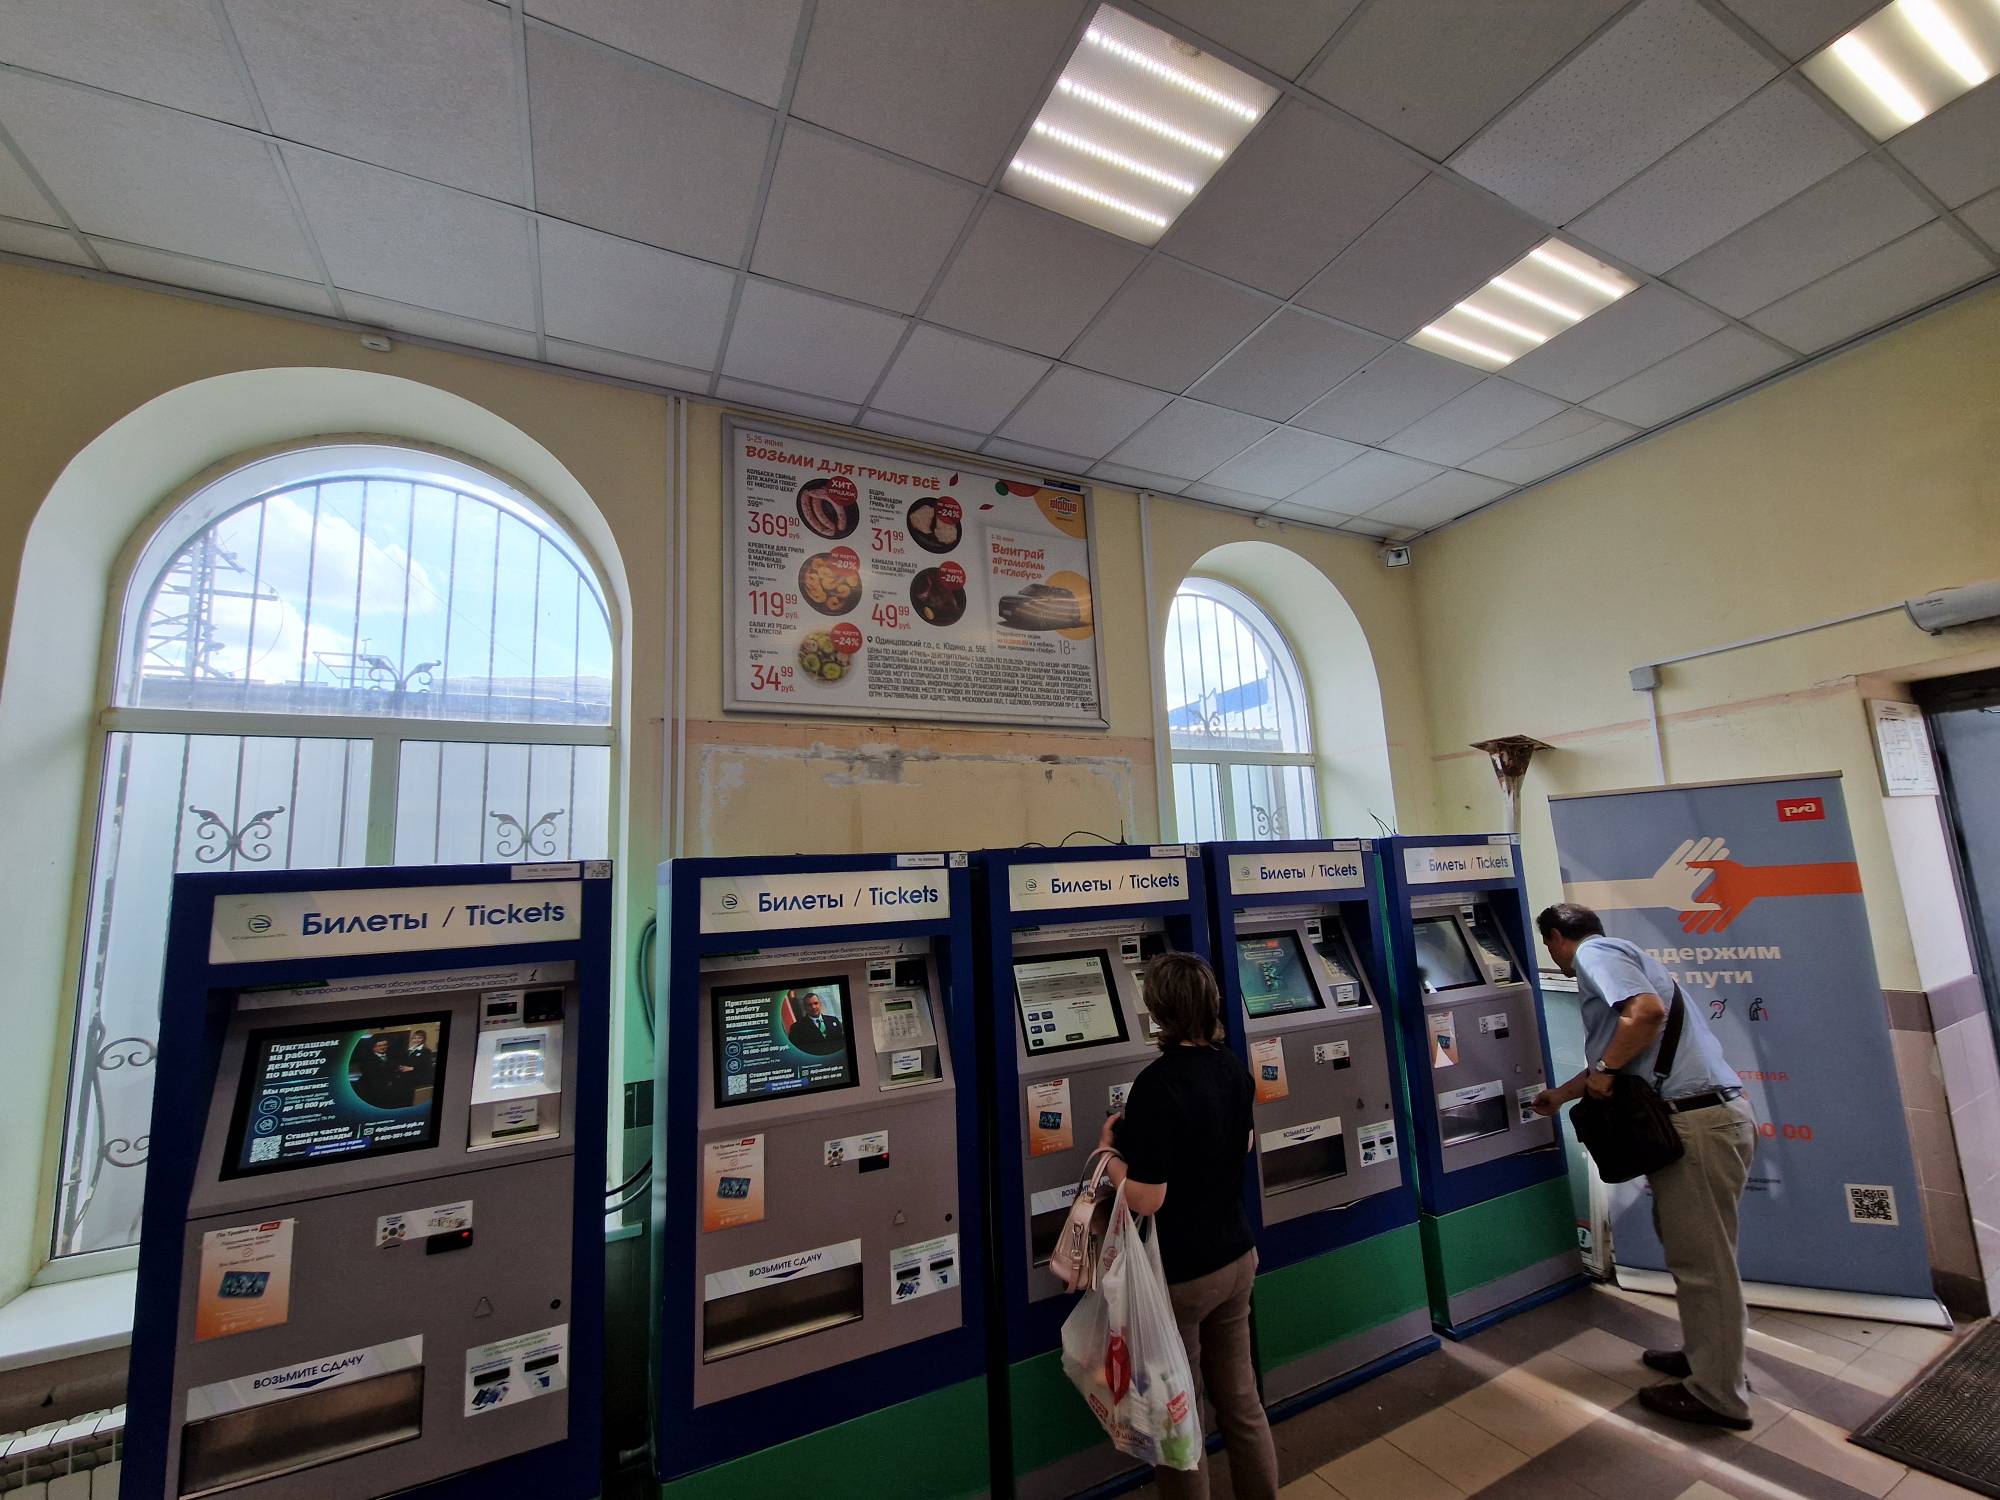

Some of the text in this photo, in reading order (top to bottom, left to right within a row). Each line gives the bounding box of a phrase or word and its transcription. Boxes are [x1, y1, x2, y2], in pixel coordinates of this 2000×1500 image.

[746, 434, 784, 448] 5-25 июня
[745, 446, 941, 491] ВОЗЬМИ ДЛЯ ГРИЛЯ ВСЁ
[832, 480, 853, 490] ХИТ
[1050, 500, 1078, 513] globus
[938, 509, 960, 519] -24%
[992, 543, 1044, 560] Выиграй
[832, 560, 857, 569] -20%
[992, 557, 1045, 570] автомобиль
[942, 575, 963, 583] -20%
[1000, 569, 1042, 580] «Глобус»
[834, 638, 860, 646] -24%
[876, 636, 922, 647] Одинцовский
[1060, 640, 1076, 655] 18+
[1429, 859, 1466, 872] Билеты
[1476, 856, 1509, 870] Tickets
[1260, 866, 1306, 880] Билеты
[1318, 864, 1357, 877] Tickets
[1052, 878, 1111, 894] Билеты
[1130, 873, 1180, 889] Tickets
[758, 890, 843, 913] Билеты
[869, 885, 938, 907] Tickets
[302, 912, 428, 936] Билеты
[466, 901, 565, 927] Tickets
[1646, 946, 1782, 965] ддержим
[528, 969, 537, 982] 1
[1686, 970, 1754, 989] пути
[725, 998, 771, 1008] Приглашаем
[736, 1006, 760, 1014] работу
[726, 1012, 769, 1022] помощника
[726, 1019, 769, 1029] машиниста
[270, 1040, 340, 1053] Приглашаем
[269, 1050, 322, 1062] на работу
[266, 1058, 326, 1071] дежурного
[281, 1067, 321, 1078] вагону
[1284, 1124, 1321, 1138] ВОЗЬМИТЕ СДАЧУ
[750, 1253, 822, 1277] ВОЗЬМИТЕ СДАЧУ
[254, 1354, 364, 1389] ВОЗЬМИТЕ СДАЧУ
